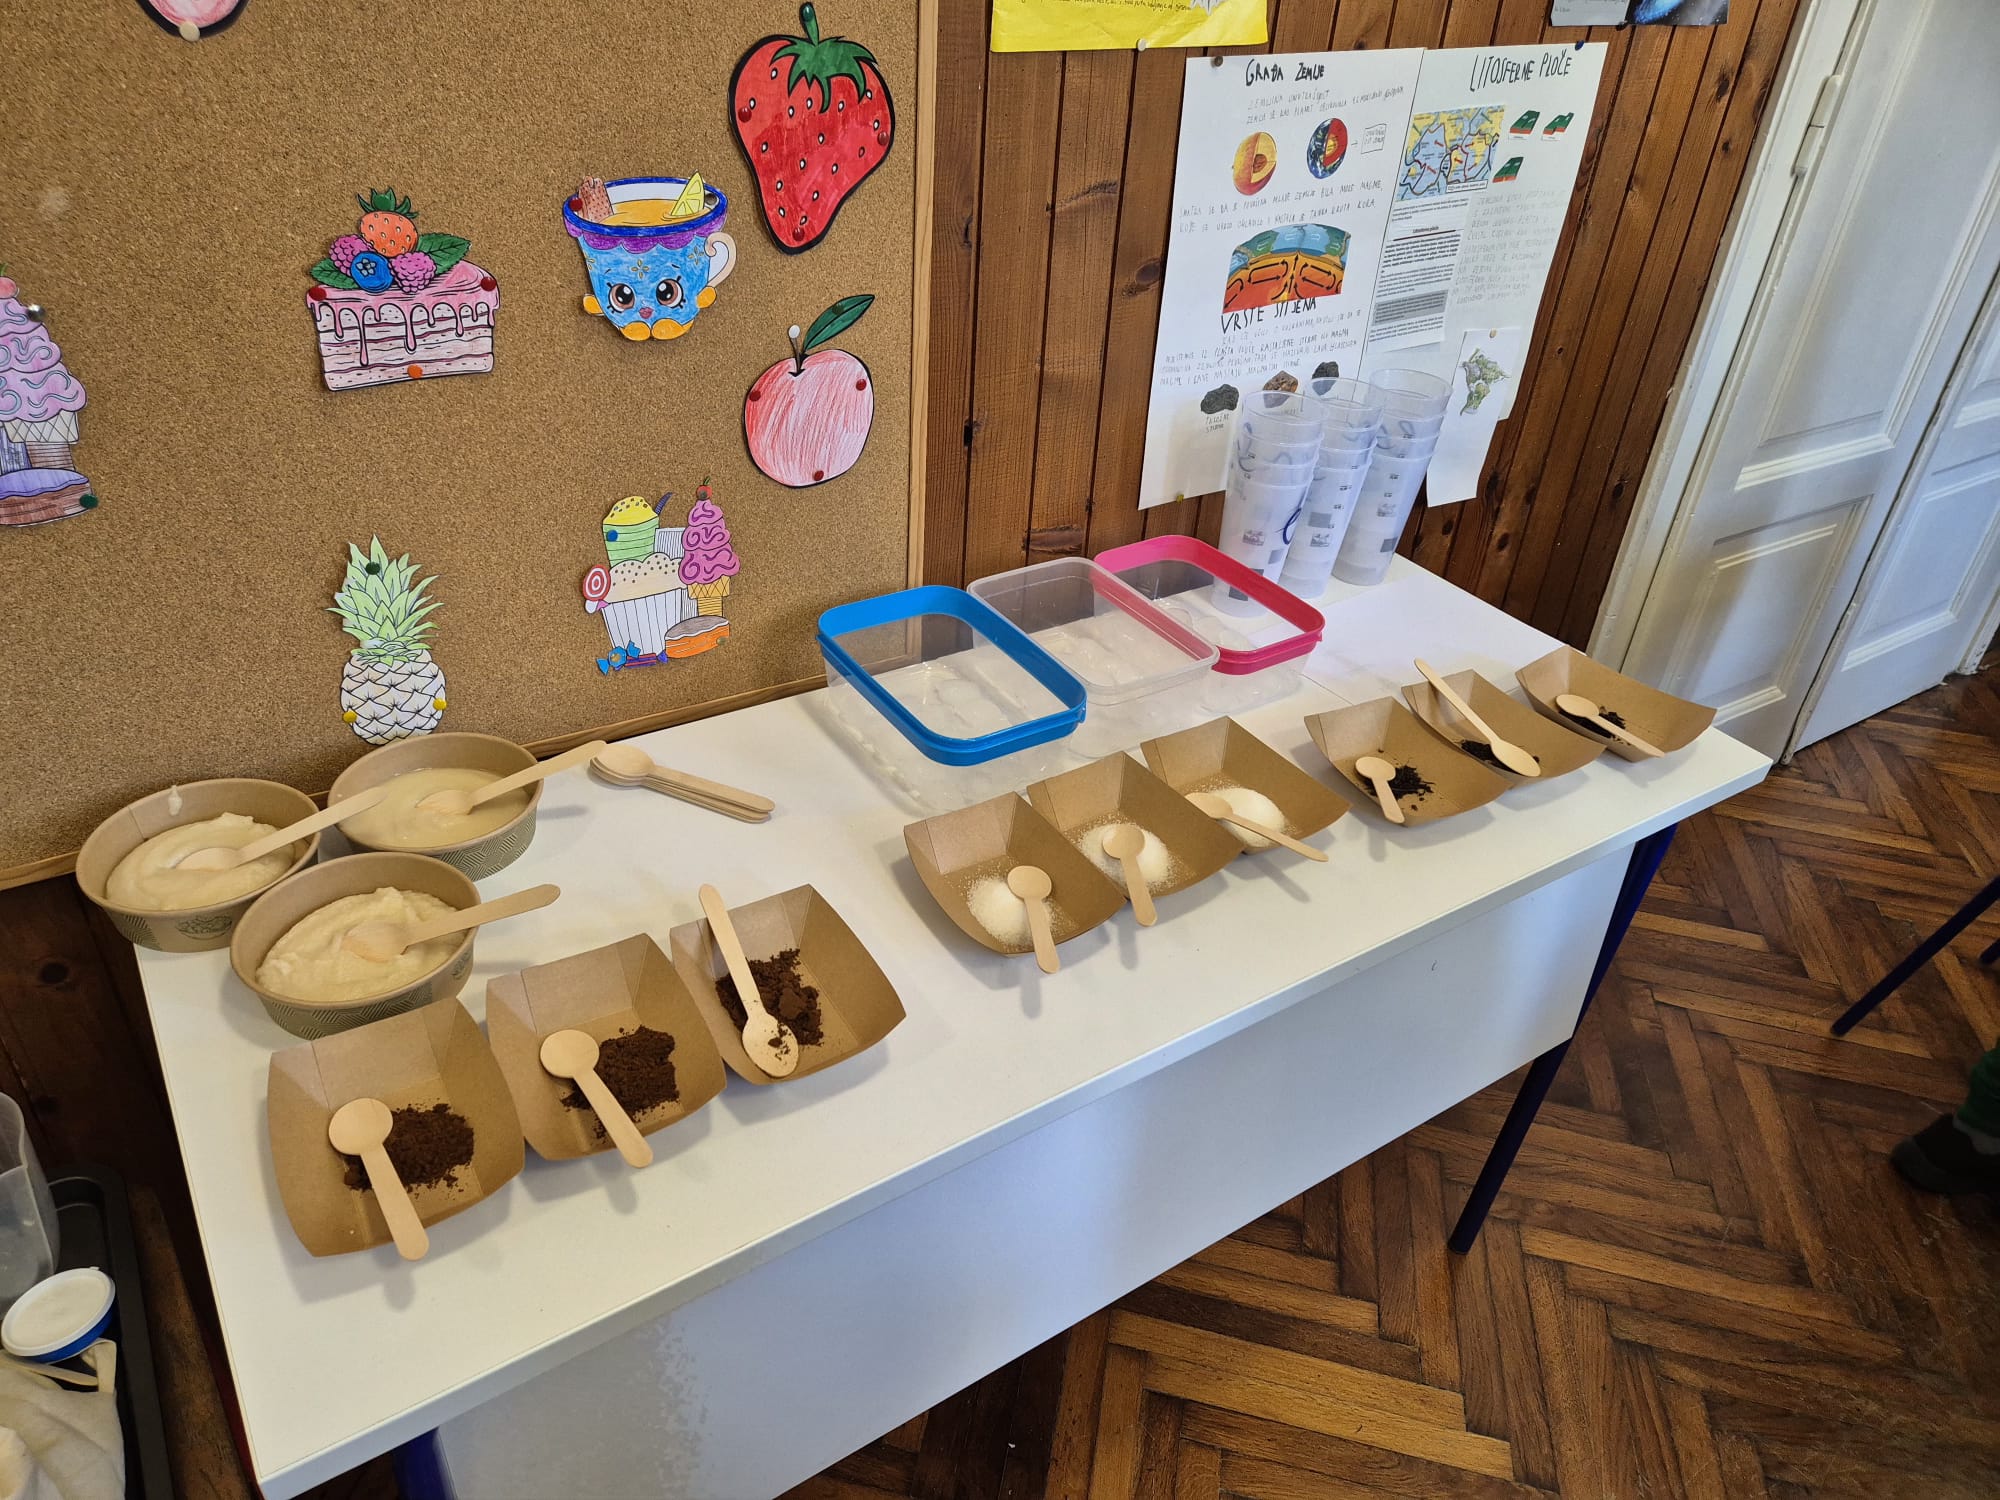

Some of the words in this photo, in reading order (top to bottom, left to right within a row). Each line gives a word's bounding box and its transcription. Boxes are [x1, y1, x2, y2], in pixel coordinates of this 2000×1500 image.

[1295, 62, 1325, 82] ZEMLJE
[1469, 54, 1535, 92] LITOSFERNE
[1539, 48, 1572, 77] PLOČE
[1221, 307, 1265, 334] VRSTE
